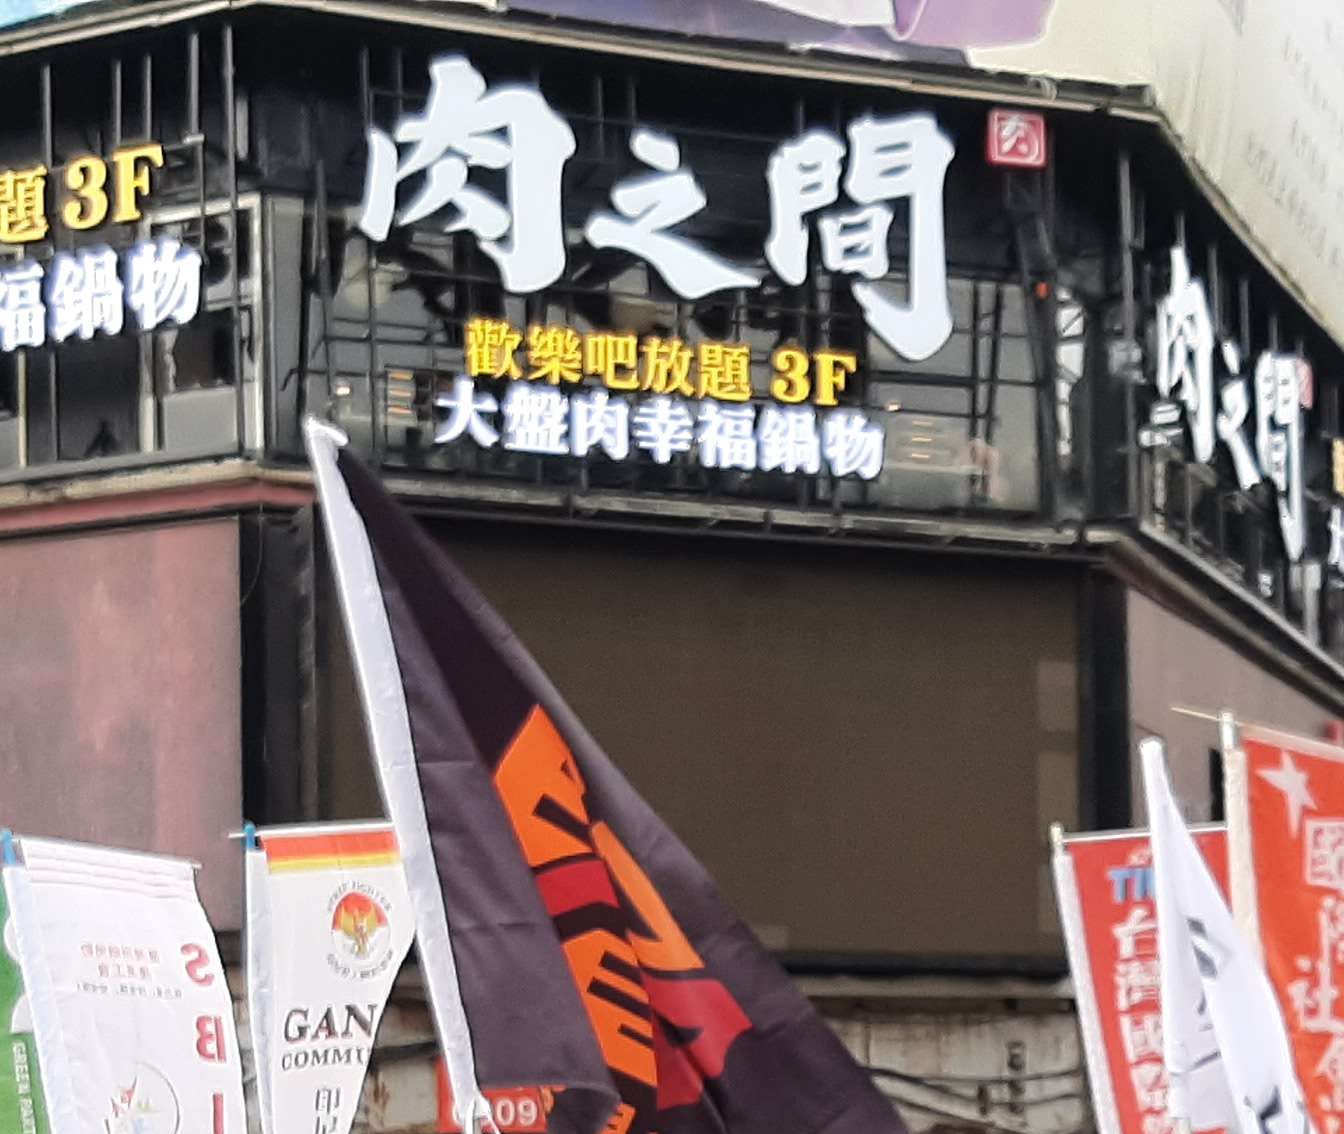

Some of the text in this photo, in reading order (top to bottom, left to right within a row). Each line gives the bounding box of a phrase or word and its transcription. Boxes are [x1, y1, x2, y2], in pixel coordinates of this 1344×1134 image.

[65, 143, 165, 230] 3F
[359, 57, 956, 361] 肉之間
[465, 318, 857, 407] 歡樂吧放題 3F
[1155, 245, 1308, 563] 肉之間
[434, 376, 885, 482] 大盤肉幸福鍋物
[283, 1002, 379, 1045] GAN
